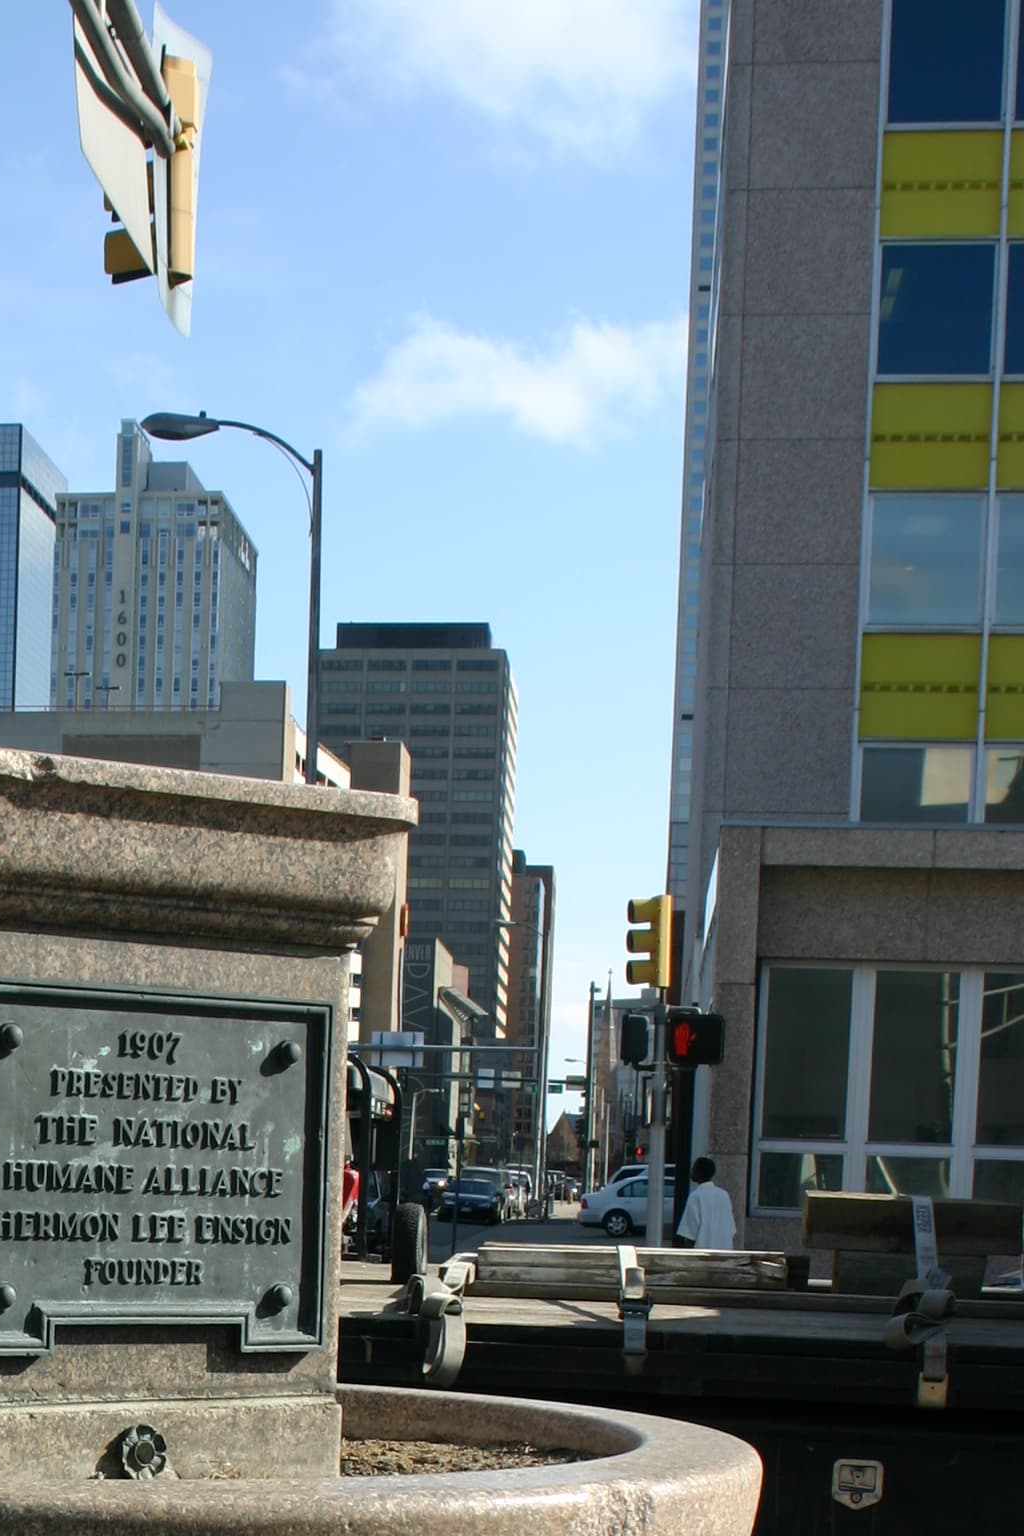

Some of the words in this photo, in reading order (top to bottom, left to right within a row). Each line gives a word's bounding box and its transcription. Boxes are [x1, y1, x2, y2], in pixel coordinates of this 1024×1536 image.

[116, 589, 127, 668] 1600
[117, 1029, 184, 1066] 1907
[50, 1067, 198, 1103] PRESENTED
[210, 1076, 243, 1106] BY
[34, 1112, 99, 1146] THE
[112, 1116, 257, 1151] NATIONAL
[2, 1159, 134, 1195] HUMANE
[142, 1164, 284, 1199] ALLIANCE
[131, 1211, 187, 1243] LEE
[195, 1213, 293, 1246] ENSIGN
[83, 1256, 204, 1287] FOUNDER
